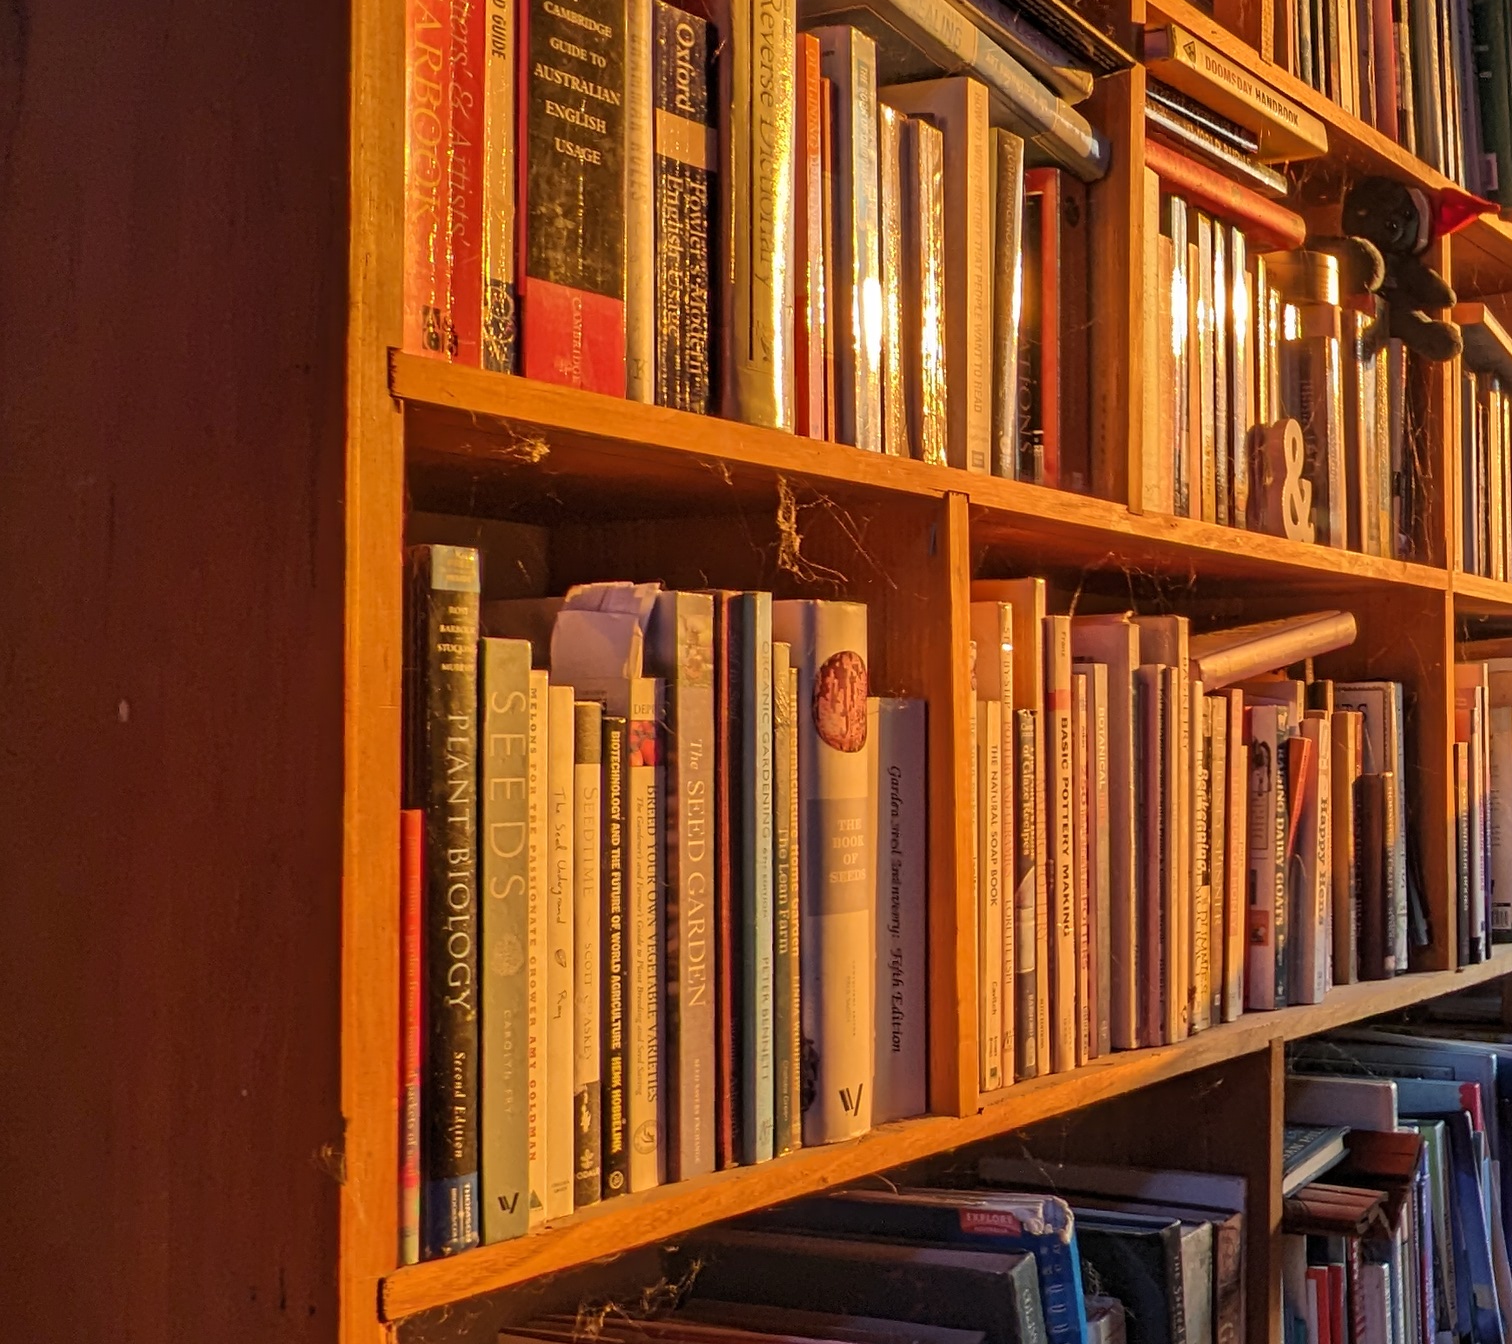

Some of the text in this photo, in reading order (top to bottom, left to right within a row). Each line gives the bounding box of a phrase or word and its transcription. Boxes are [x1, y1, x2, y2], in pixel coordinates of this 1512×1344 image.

[491, 15, 508, 61] GUIDE
[543, 0, 613, 39] CAMBRIDGE
[550, 38, 607, 68] GUIDE TO
[675, 22, 696, 114] Oxford
[534, 63, 621, 107] AUSTRALIAN
[1205, 55, 1299, 126] DOOMSDAY HANDBOOK
[545, 100, 607, 135] ENGLISH
[555, 137, 602, 166] USAGE
[689, 180, 708, 276] Fowler's
[755, 118, 779, 288] Dictionary
[666, 174, 684, 338] English Usage
[973, 240, 983, 271] THAT
[972, 275, 983, 320] PEOPLE
[972, 323, 982, 357] WANT
[972, 361, 982, 377] TO
[972, 379, 982, 413] READ
[1181, 656, 1190, 751] BASKETRY
[761, 641, 770, 839] ORGANIC GARDENING
[990, 744, 998, 767] THE
[1098, 707, 1107, 790] BOTANICAL
[489, 691, 526, 900] SEEDS
[554, 790, 567, 814] The
[990, 771, 998, 827] NATURAL
[1022, 763, 1034, 804] Glaze
[1061, 630, 1071, 937] Franz BASIC POTTERY MAKING
[832, 834, 865, 849] BOOK
[837, 819, 862, 832] THE
[990, 831, 998, 866] SOAP
[1020, 807, 1033, 857] Recipes
[1275, 817, 1286, 868] DAIRY
[446, 714, 471, 1014] PLANT BIOLOGY
[687, 739, 706, 1007] The SEED GARDEN
[830, 867, 867, 884] SEEDS
[843, 851, 860, 864] OF
[1317, 796, 1328, 927] Happy Hens
[582, 786, 600, 987] SEEDTIME SCOTT
[778, 827, 790, 955] The Farm
[990, 869, 998, 907] BOOK
[1275, 872, 1286, 926] GOATS
[529, 687, 538, 1163] MELONS FOR THE PASSIONATE GROWER AMY GOLDMAN
[609, 731, 622, 1153] BIOTECHNOLOGY AND THE FUTURE OF WORLD AGRICULTURE HENK HOBBELINK
[646, 785, 658, 1103] BREED YOUR OWN VEGETABLE VARIETIES
[502, 1009, 513, 1081] CAROLYN
[760, 956, 771, 1081] PETER BENNETT
[890, 991, 904, 1053] Edition
[453, 1050, 467, 1158] Second Edition
